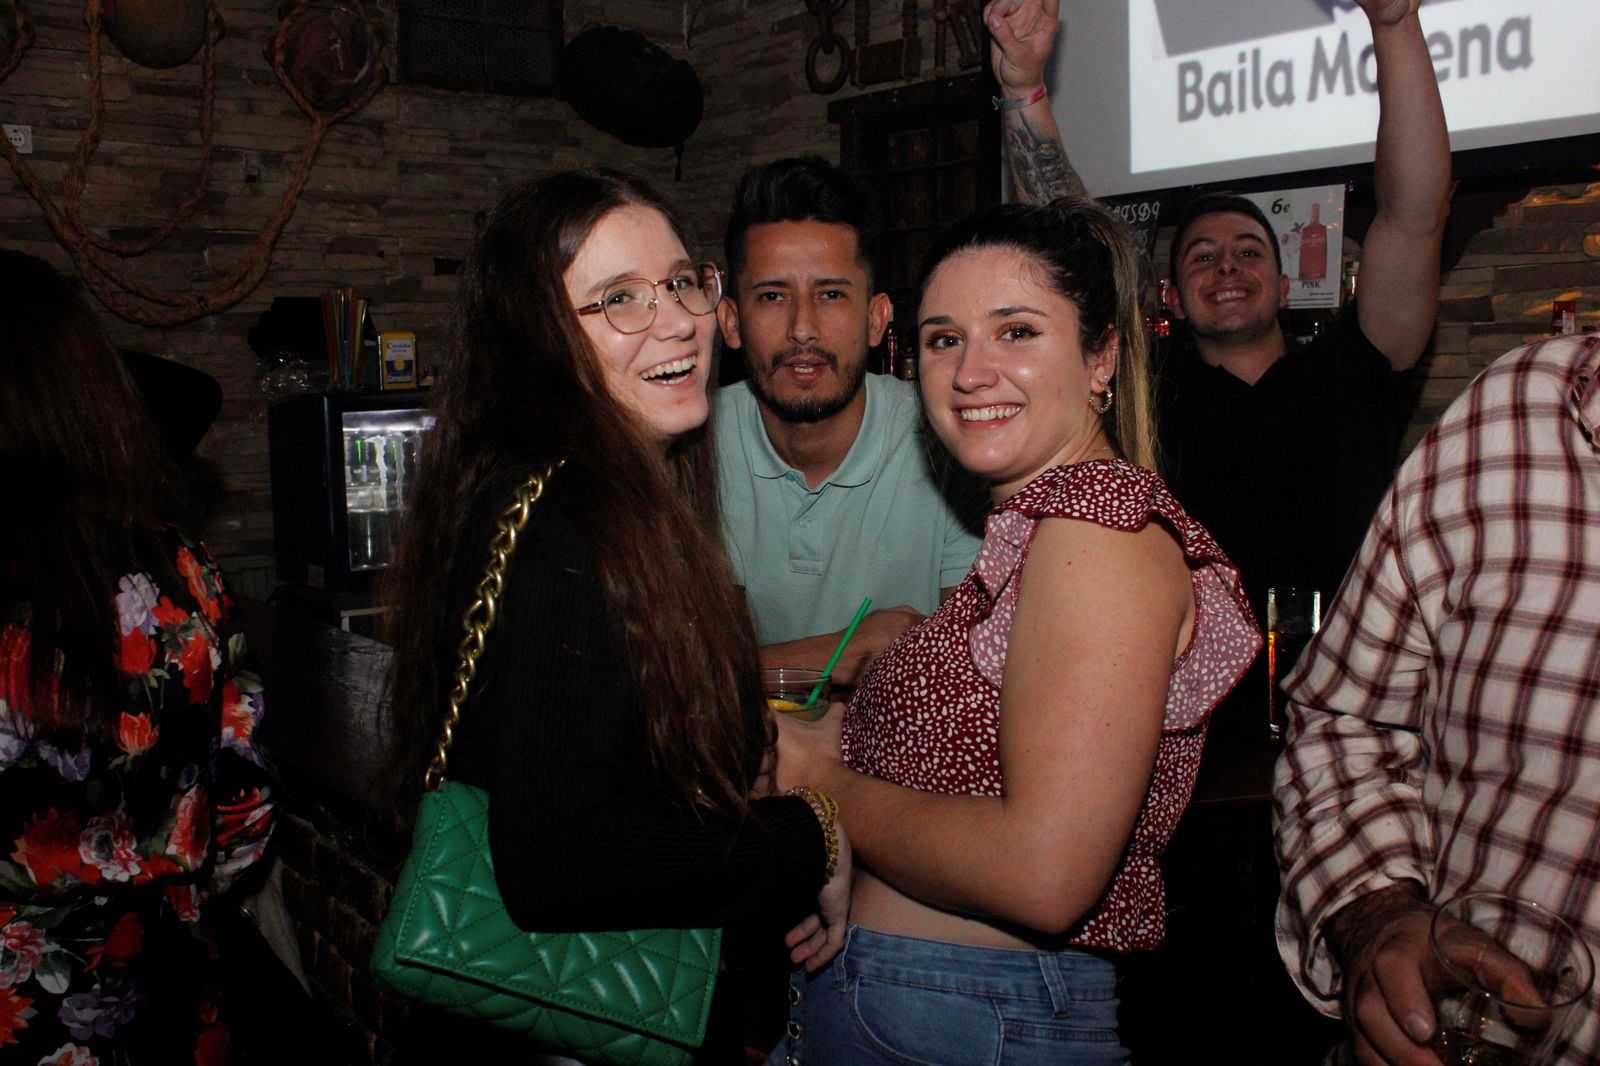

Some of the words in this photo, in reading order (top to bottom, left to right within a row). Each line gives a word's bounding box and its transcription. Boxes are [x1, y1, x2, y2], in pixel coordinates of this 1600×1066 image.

[1178, 48, 1295, 123] Baila
[1307, 15, 1535, 103] Moena
[1271, 198, 1291, 214] 6€
[1302, 280, 1321, 289] PINK
